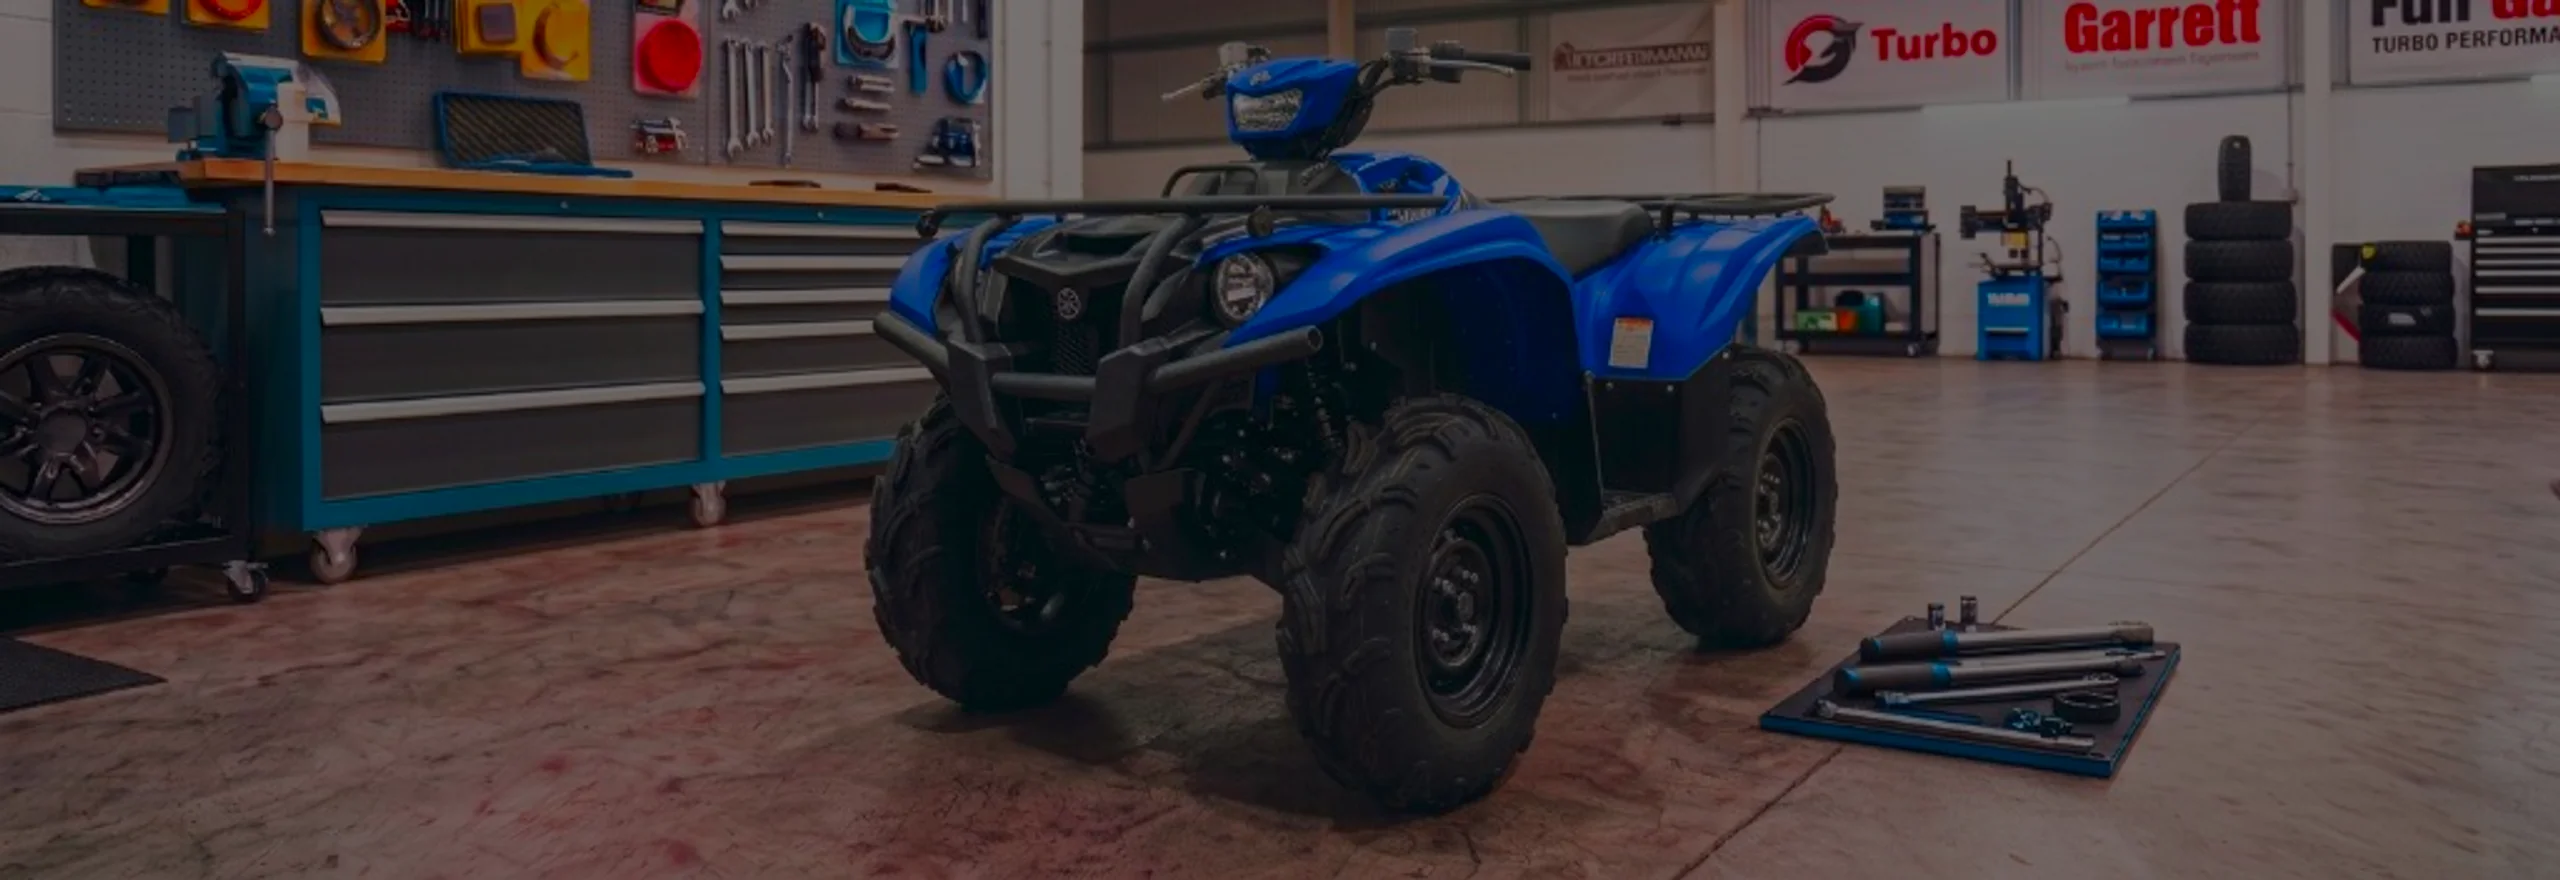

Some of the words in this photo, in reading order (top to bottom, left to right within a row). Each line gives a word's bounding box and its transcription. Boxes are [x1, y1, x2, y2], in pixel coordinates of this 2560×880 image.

[1871, 22, 1997, 60] Turbo
[2065, 0, 2260, 53] Garrett
[2372, 33, 2438, 53] TURBO
[2446, 25, 2560, 49] PERFORMA
